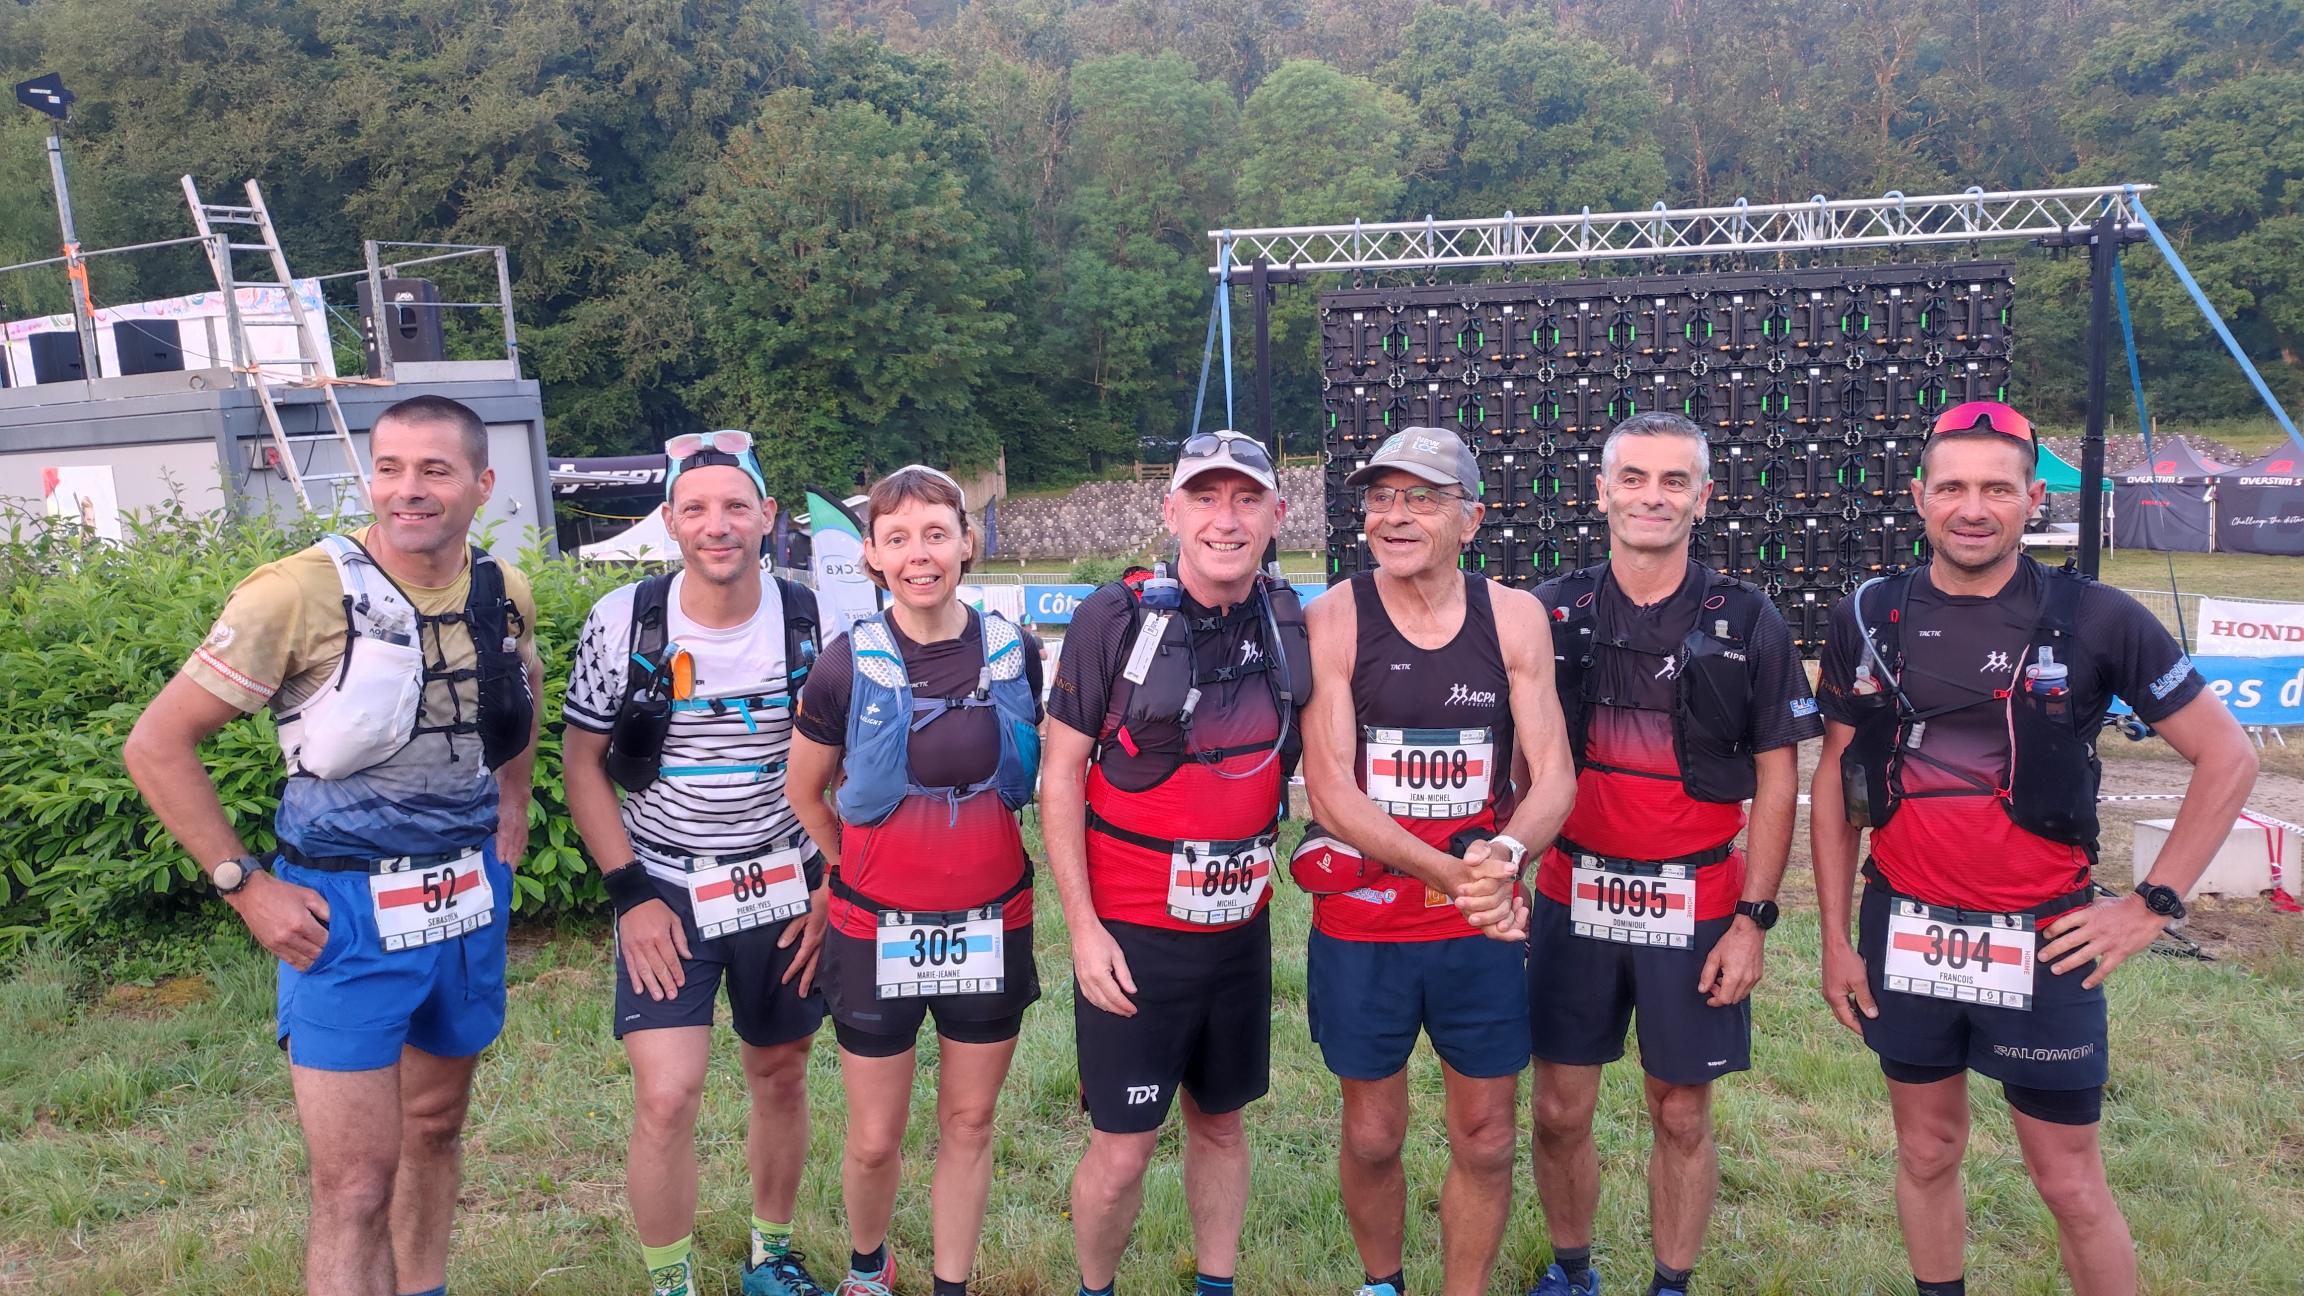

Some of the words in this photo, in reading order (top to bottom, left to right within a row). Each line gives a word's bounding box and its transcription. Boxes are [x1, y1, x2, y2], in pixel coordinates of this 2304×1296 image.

[1468, 691, 1496, 703] ACPA
[1391, 749, 1468, 790] 1008
[1410, 793, 1451, 802] JEAN-MICHEL
[730, 861, 767, 903] 88
[1202, 855, 1254, 897] 866
[422, 867, 458, 913] 52
[1594, 875, 1667, 919] 1095
[736, 900, 771, 915] PIERRE-YVES
[1216, 899, 1238, 908] MICHEL
[427, 912, 459, 927] SEBASTIEN
[1613, 918, 1647, 930] DOMINIQUE
[909, 926, 968, 967] 305
[1923, 924, 1993, 973] 304
[916, 970, 961, 980] MARIE-JEANNE
[1939, 972, 1974, 985] FRANCOIS
[1993, 1043, 2094, 1061] SALOMON
[1127, 1085, 1160, 1105] TDR
